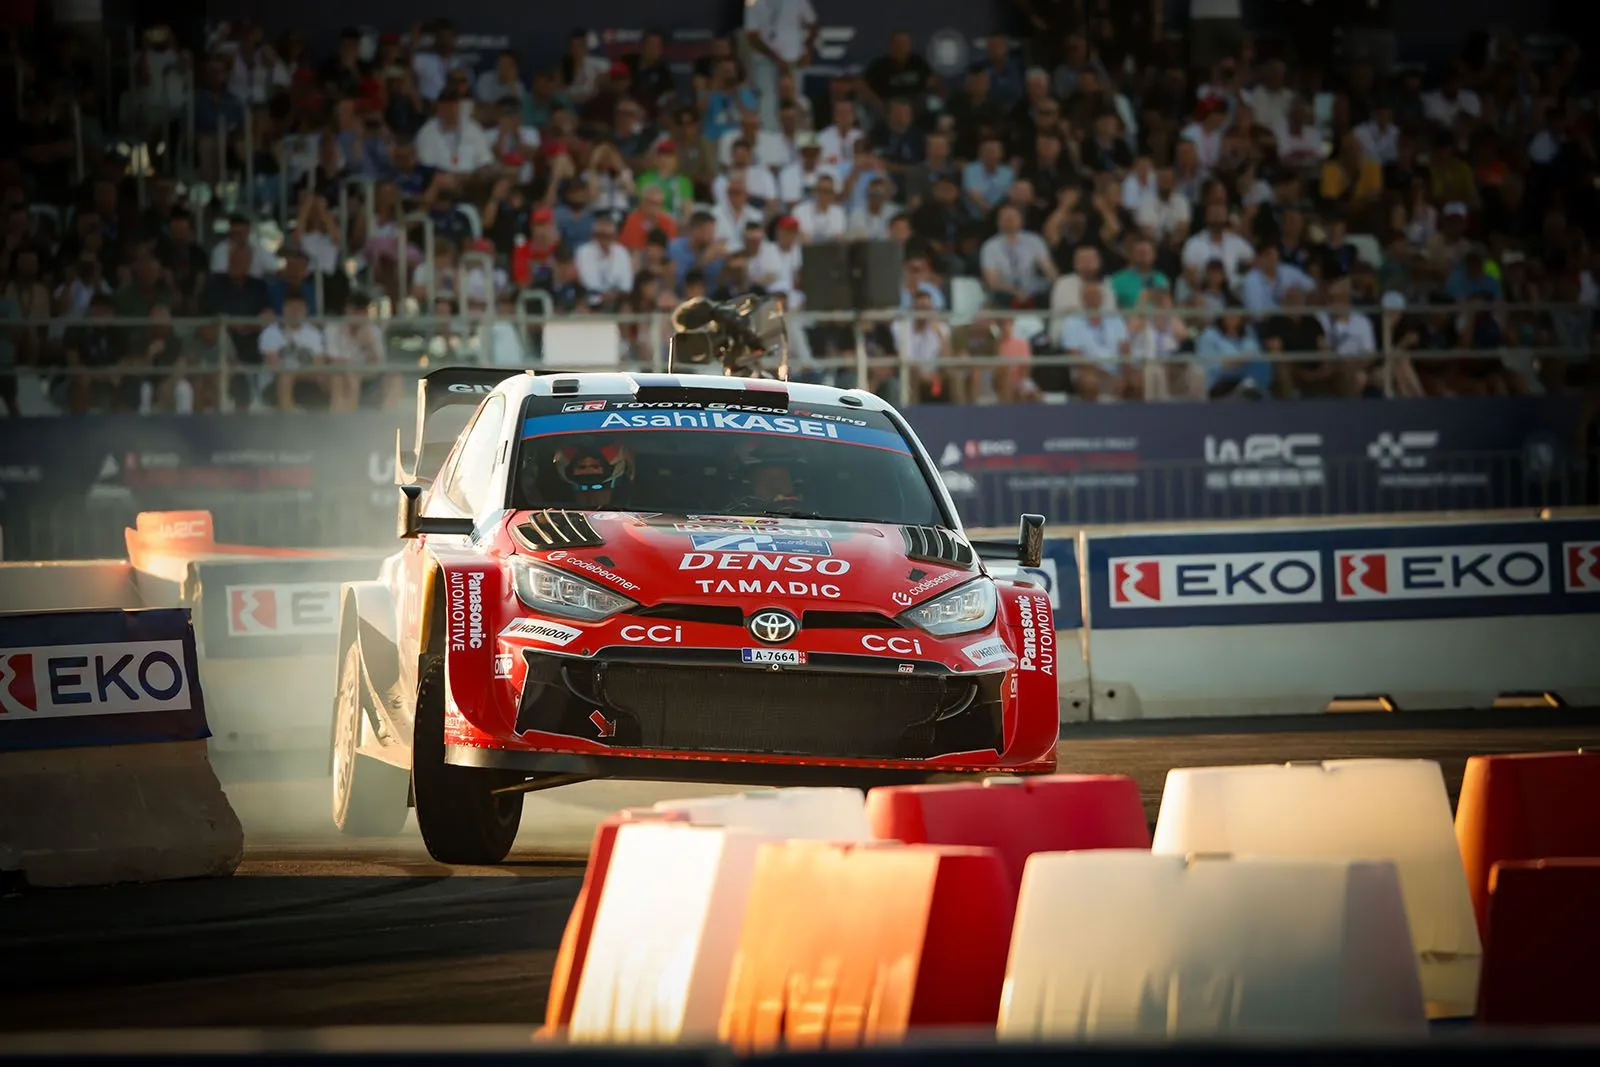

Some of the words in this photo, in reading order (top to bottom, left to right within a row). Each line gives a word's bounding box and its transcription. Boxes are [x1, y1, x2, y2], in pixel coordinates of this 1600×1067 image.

[707, 402, 789, 414] GAZOO
[794, 409, 867, 426] Racing
[566, 557, 639, 591] codebeamer
[678, 552, 851, 576] DENSO
[1176, 559, 1316, 597] EKO
[1402, 552, 1544, 590] EKO
[695, 579, 841, 598] TAMADIC
[451, 571, 465, 651] AUTOMOTIVE
[468, 572, 486, 649] Panasonic
[1015, 595, 1036, 671] Panasonic
[1033, 596, 1053, 675] AUTOMOTIVE
[755, 651, 795, 661] A-7664
[47, 650, 183, 706] EKO
